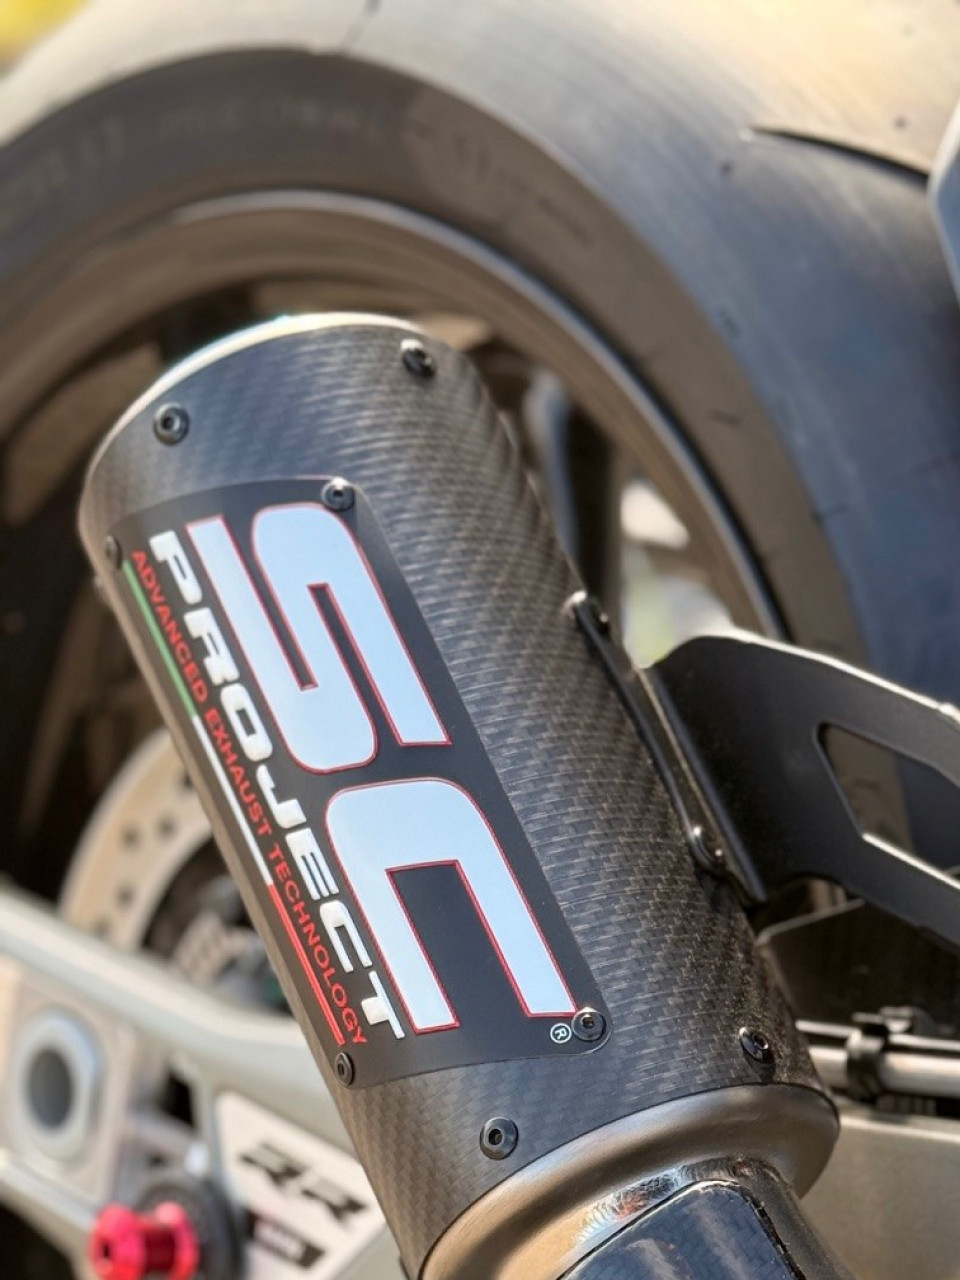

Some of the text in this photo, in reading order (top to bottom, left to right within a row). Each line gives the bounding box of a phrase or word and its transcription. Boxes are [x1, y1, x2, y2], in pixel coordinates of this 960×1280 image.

[131, 549, 369, 1044] ADVANCED EXHAUST TECHNOLOGY
[149, 530, 405, 1039] PROJECT
[186, 503, 577, 1035] SC
